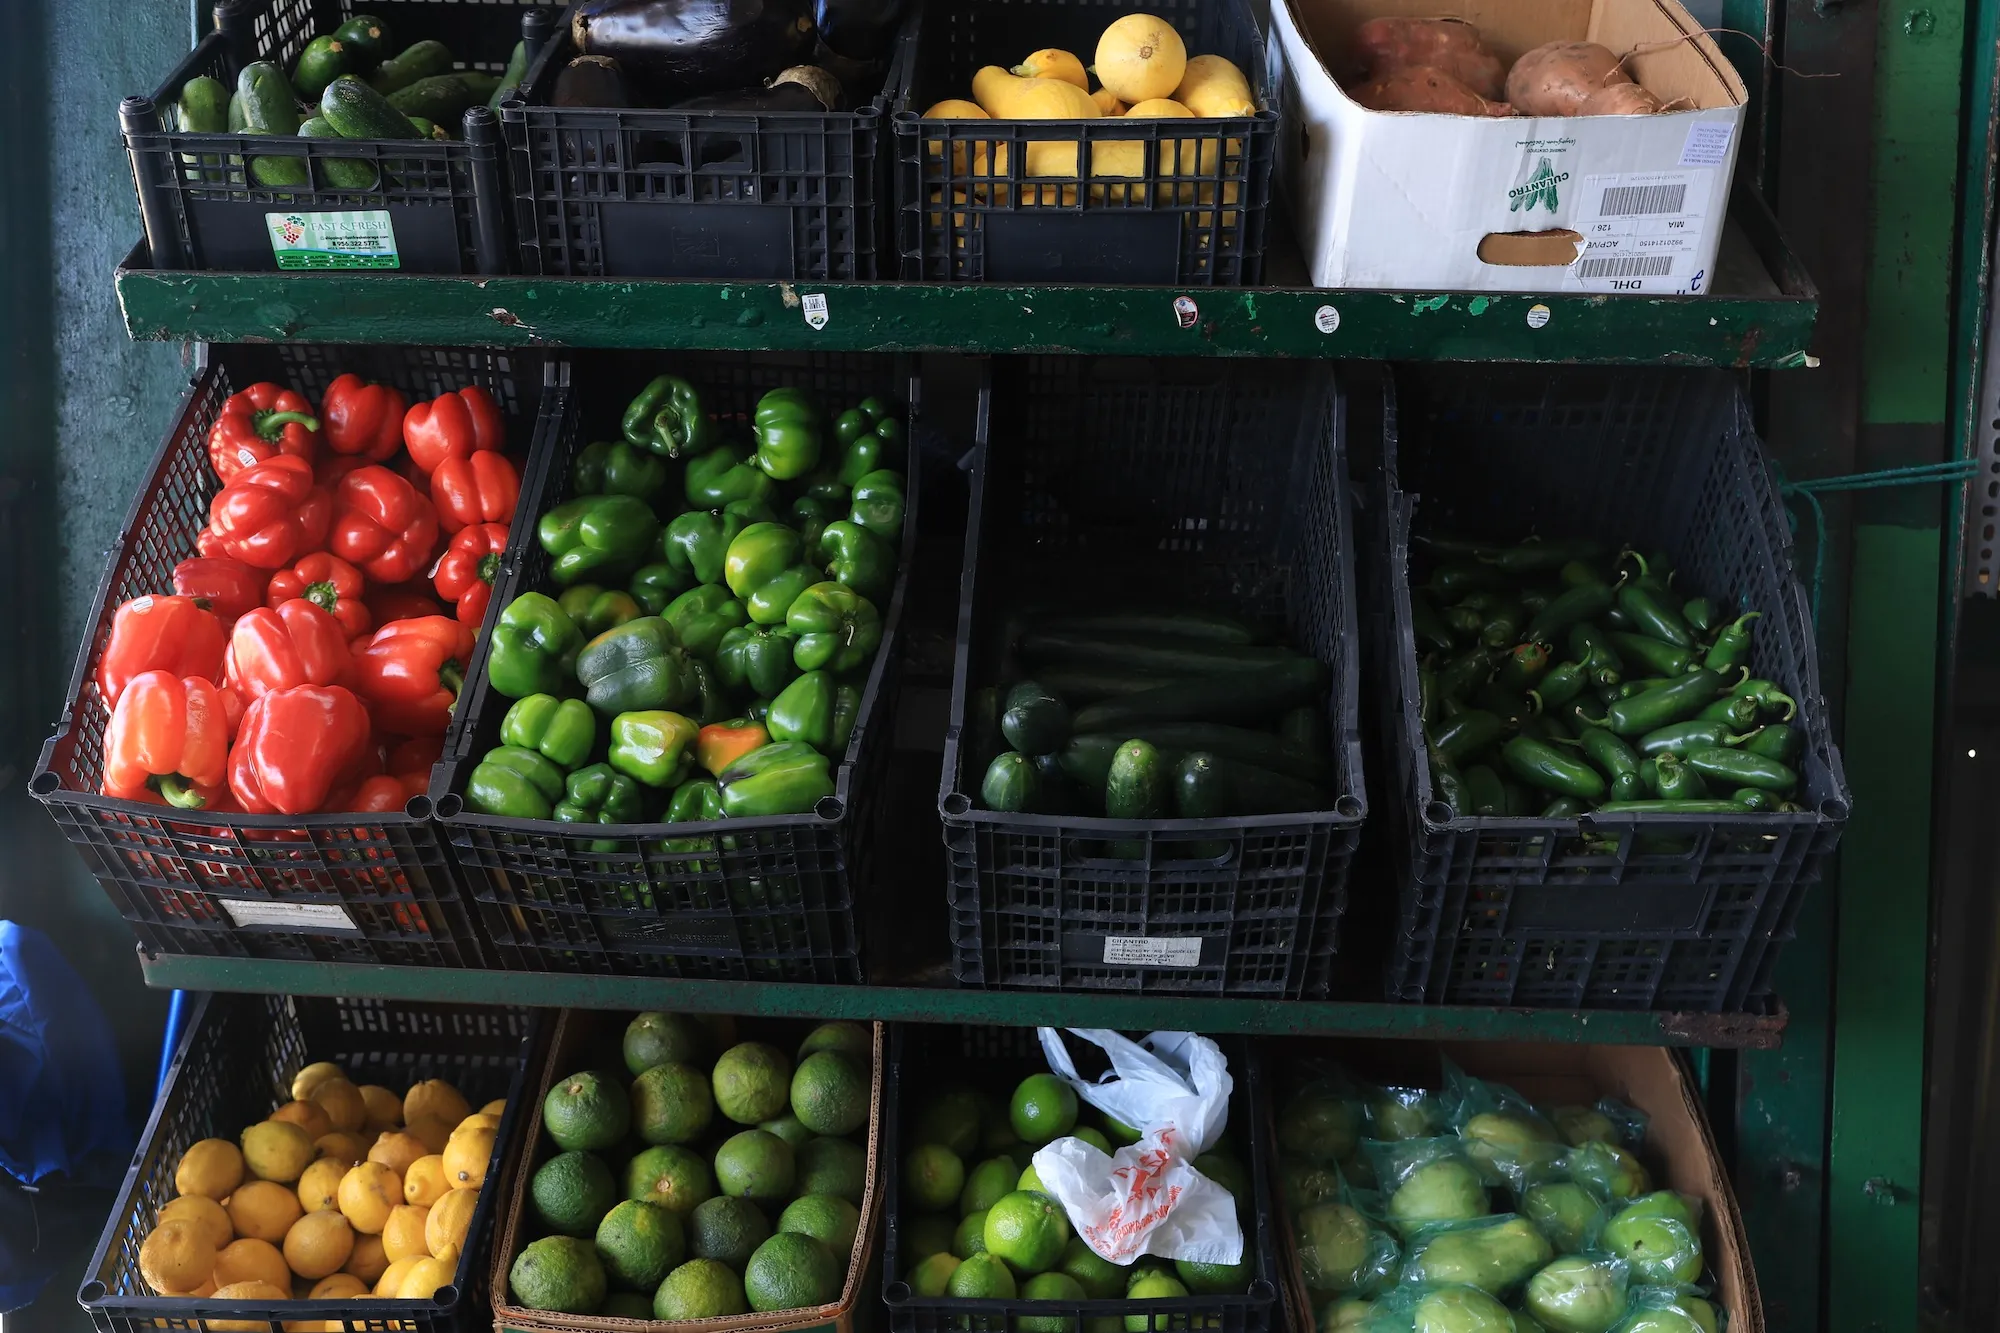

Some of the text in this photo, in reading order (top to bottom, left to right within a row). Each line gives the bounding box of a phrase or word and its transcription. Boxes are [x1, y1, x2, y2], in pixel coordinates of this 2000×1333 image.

[1508, 172, 1569, 198] CULANTRO
[310, 221, 387, 232] FAST & FRESH
[1668, 220, 1685, 228] MIA
[1609, 280, 1642, 290] DHL
